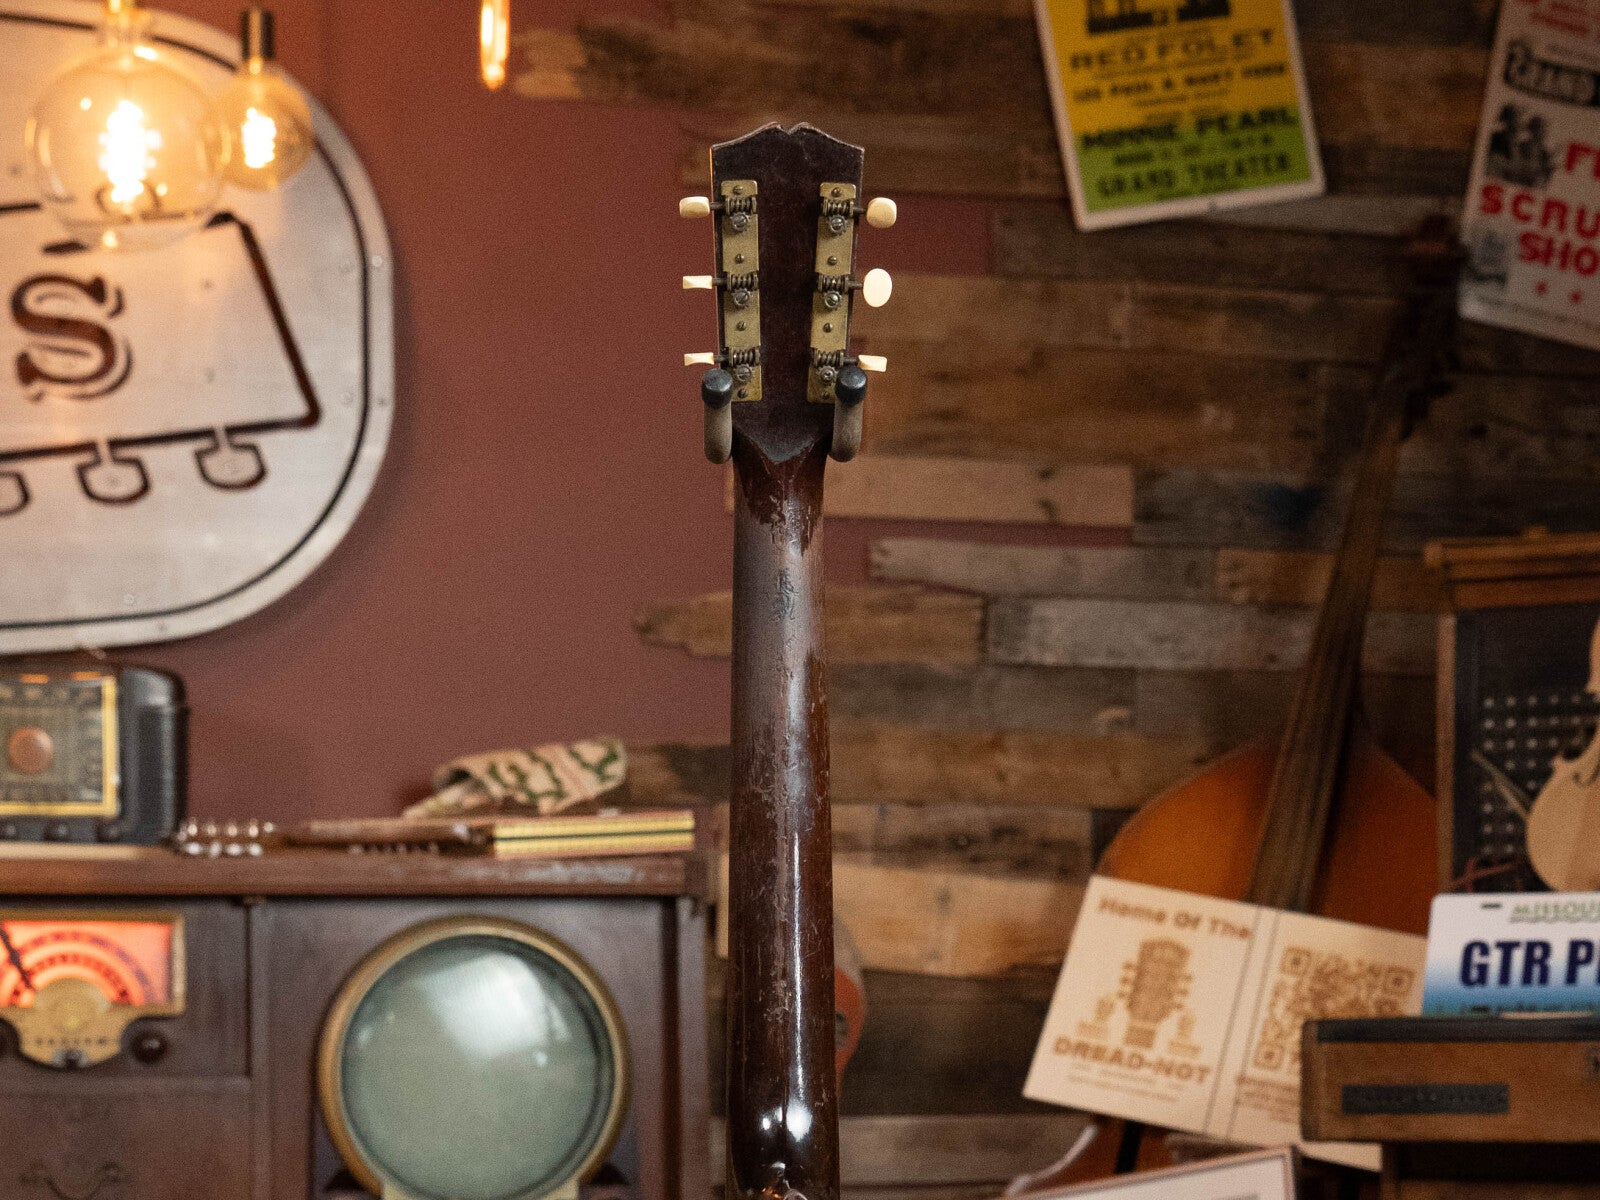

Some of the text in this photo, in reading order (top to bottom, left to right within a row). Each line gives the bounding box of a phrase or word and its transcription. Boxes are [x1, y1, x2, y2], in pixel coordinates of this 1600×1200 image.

[1070, 46, 1147, 70] RED
[1157, 27, 1274, 58] FOLEY
[1082, 121, 1177, 149] MINNIE
[1195, 107, 1299, 136] PEARL
[1188, 153, 1289, 182] THEATER
[1099, 898, 1254, 941] Home Of The
[1460, 940, 1551, 987] GTR
[1052, 1036, 1211, 1084] DREAD-NOT
